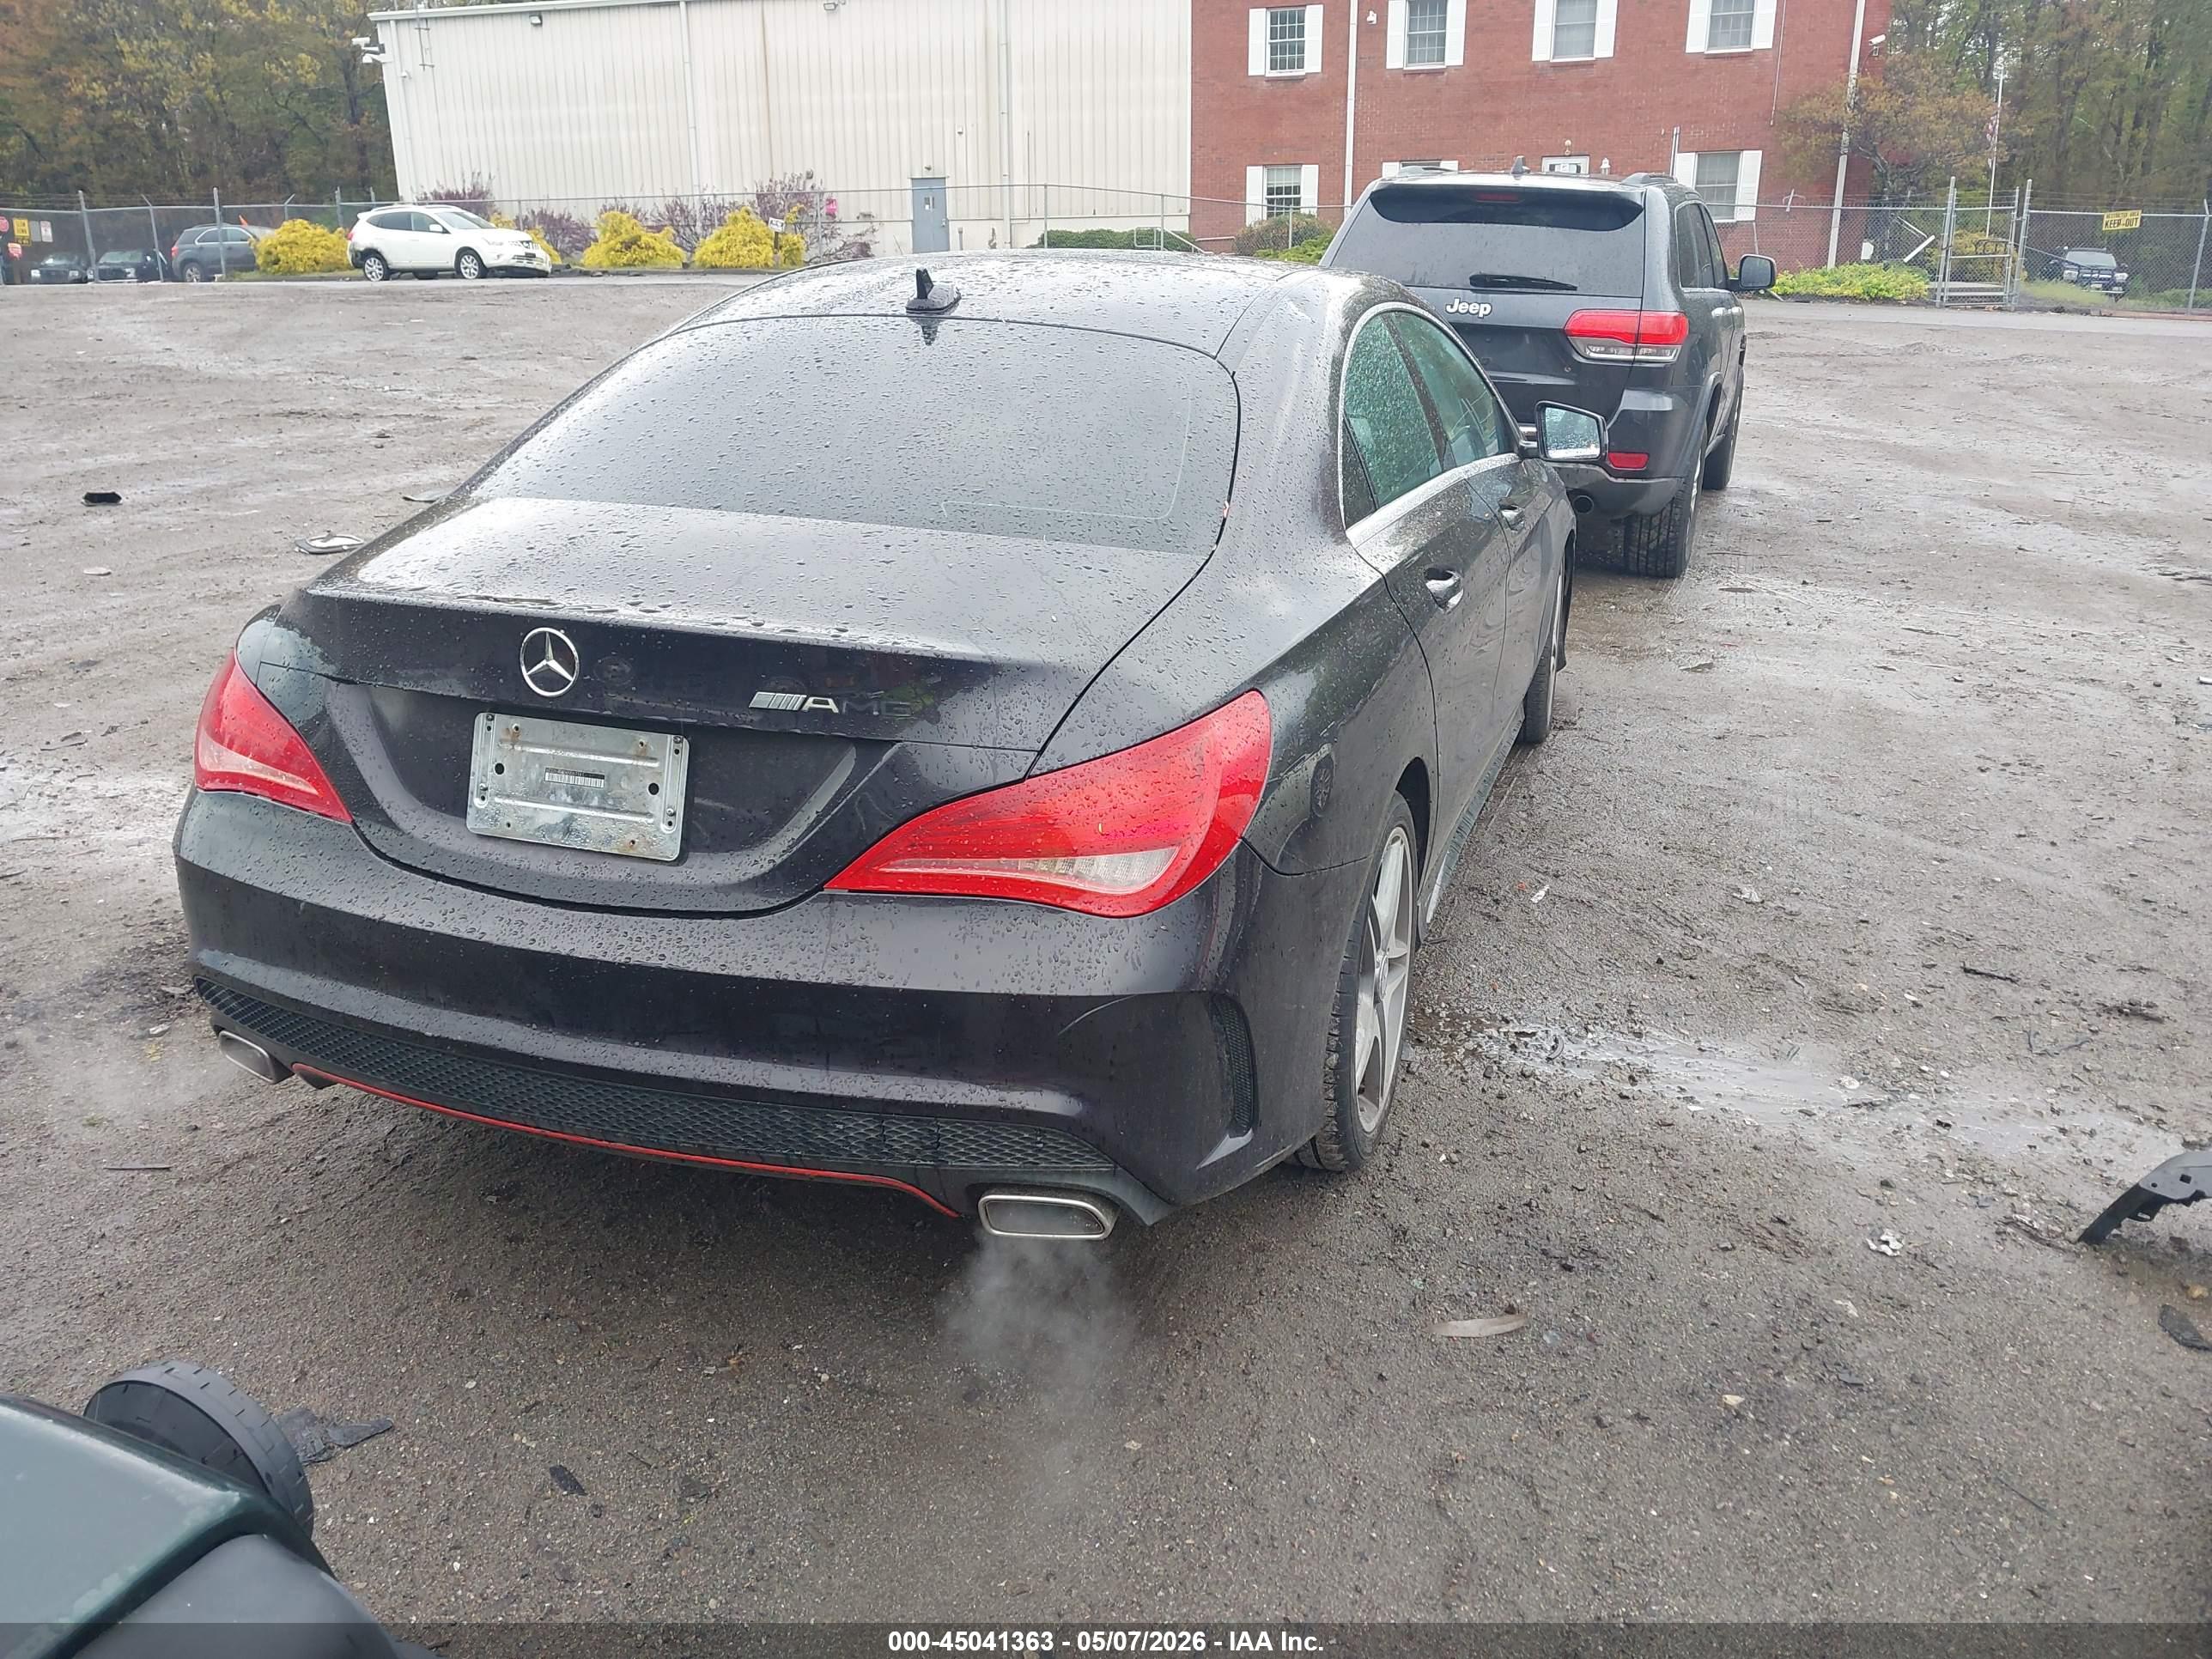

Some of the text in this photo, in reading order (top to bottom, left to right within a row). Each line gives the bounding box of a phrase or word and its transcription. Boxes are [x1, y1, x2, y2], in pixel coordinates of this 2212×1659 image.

[2105, 217, 2139, 228] KEEP OUT
[1445, 297, 1492, 319] Jeep
